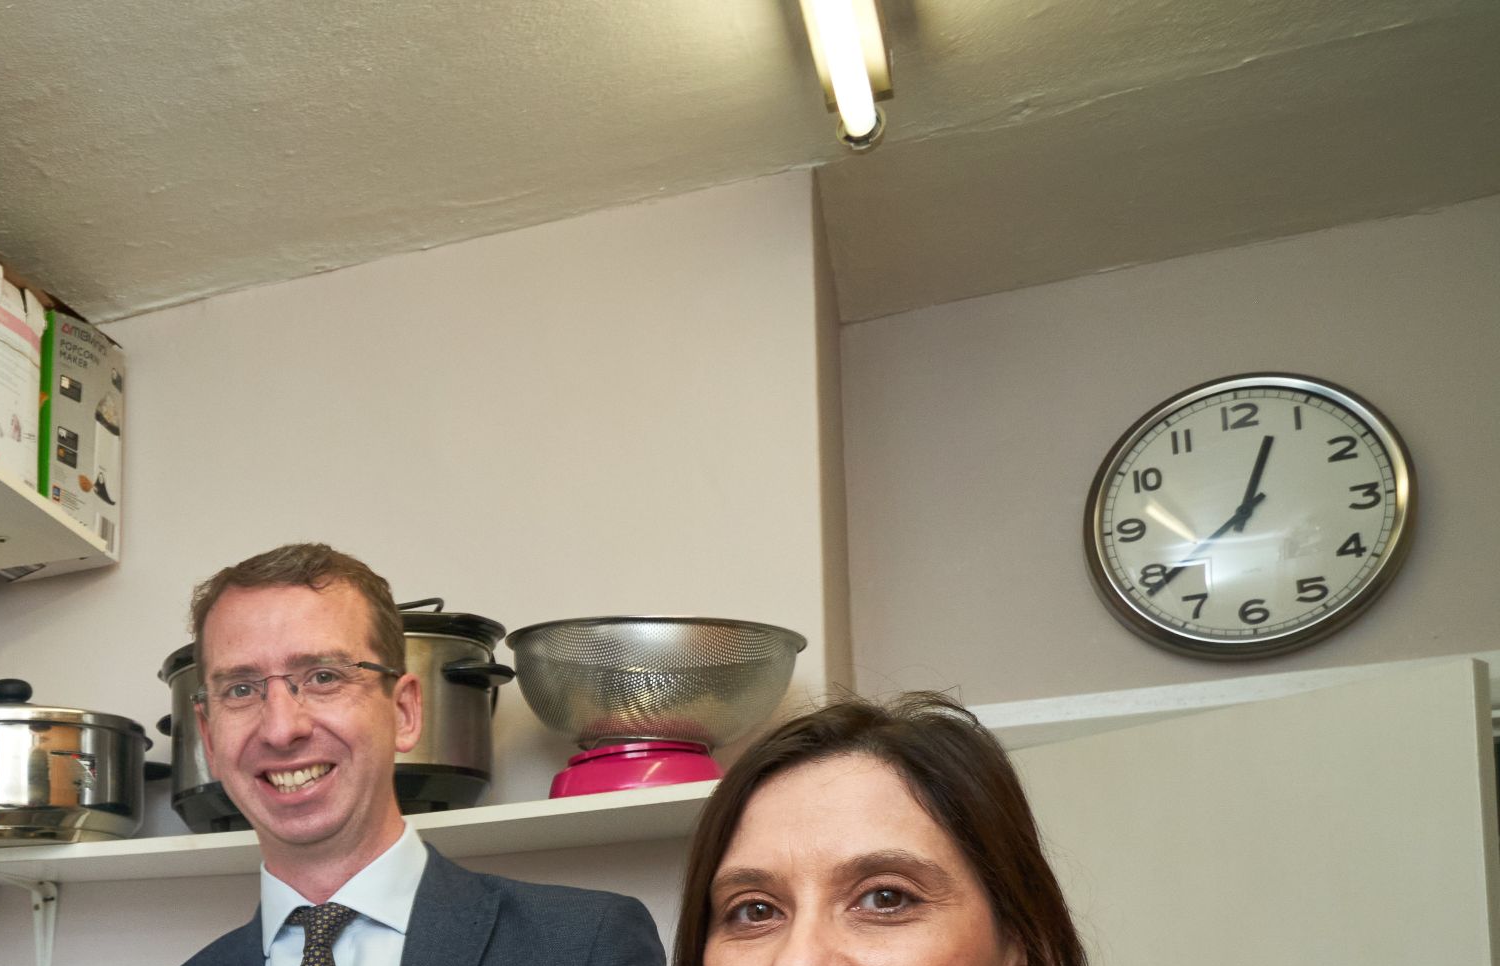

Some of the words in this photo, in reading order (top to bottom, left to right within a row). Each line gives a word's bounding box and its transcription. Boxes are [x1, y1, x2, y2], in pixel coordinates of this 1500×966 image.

[1220, 402, 1259, 431] 12
[1293, 405, 1302, 431] 1
[1170, 428, 1192, 455] 11
[1326, 435, 1359, 463] 2
[1132, 466, 1163, 494] 10
[1348, 481, 1382, 510] 3
[1115, 517, 1147, 543] 9
[1335, 532, 1367, 558] 4
[1138, 562, 1168, 589] 8
[1296, 575, 1329, 603] 5
[1181, 592, 1208, 619] 7
[1237, 598, 1270, 625] 6
